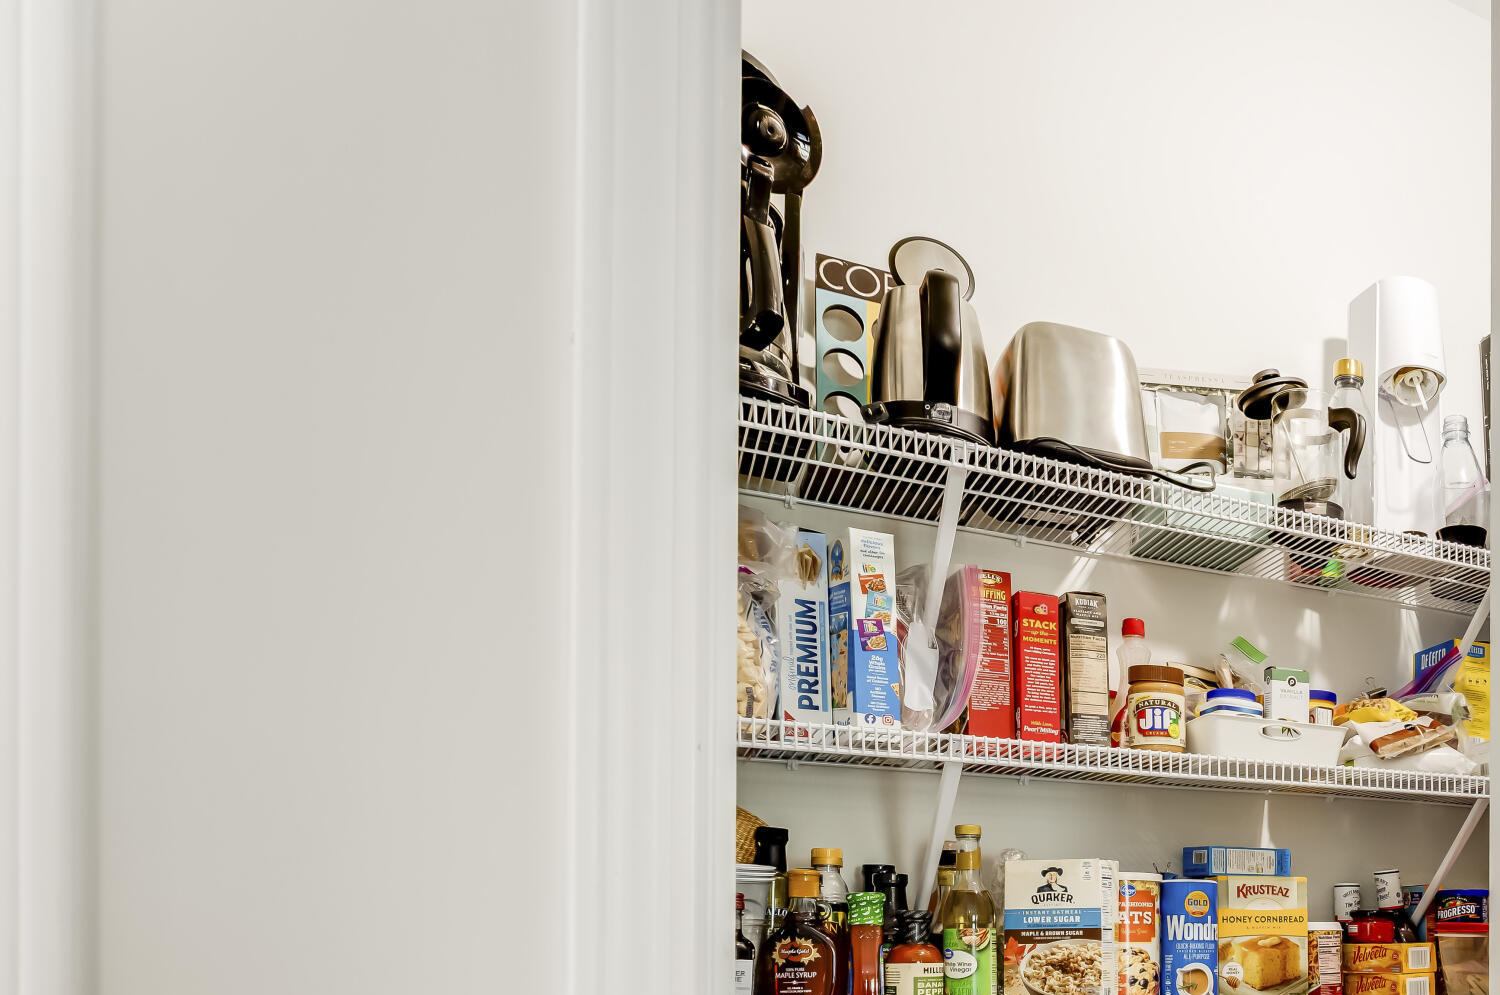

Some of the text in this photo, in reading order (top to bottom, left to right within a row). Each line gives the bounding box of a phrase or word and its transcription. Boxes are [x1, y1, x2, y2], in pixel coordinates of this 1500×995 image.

[1022, 618, 1057, 630] STACK
[1022, 635, 1057, 645] MOMENTS
[794, 598, 820, 711] PREMIUM
[1138, 699, 1177, 709] NATURAL
[1138, 707, 1178, 730] Jif
[1236, 883, 1290, 899] KRUSTEAZ
[1031, 893, 1074, 904] QUAKER
[1187, 898, 1208, 906] GOLD
[1118, 911, 1152, 925] ATS
[1437, 904, 1476, 920] PROGRESSO
[1221, 915, 1305, 924] HONEY CORNBREAD
[1352, 945, 1387, 965] Velveeta
[1355, 975, 1387, 994] Velveeta
